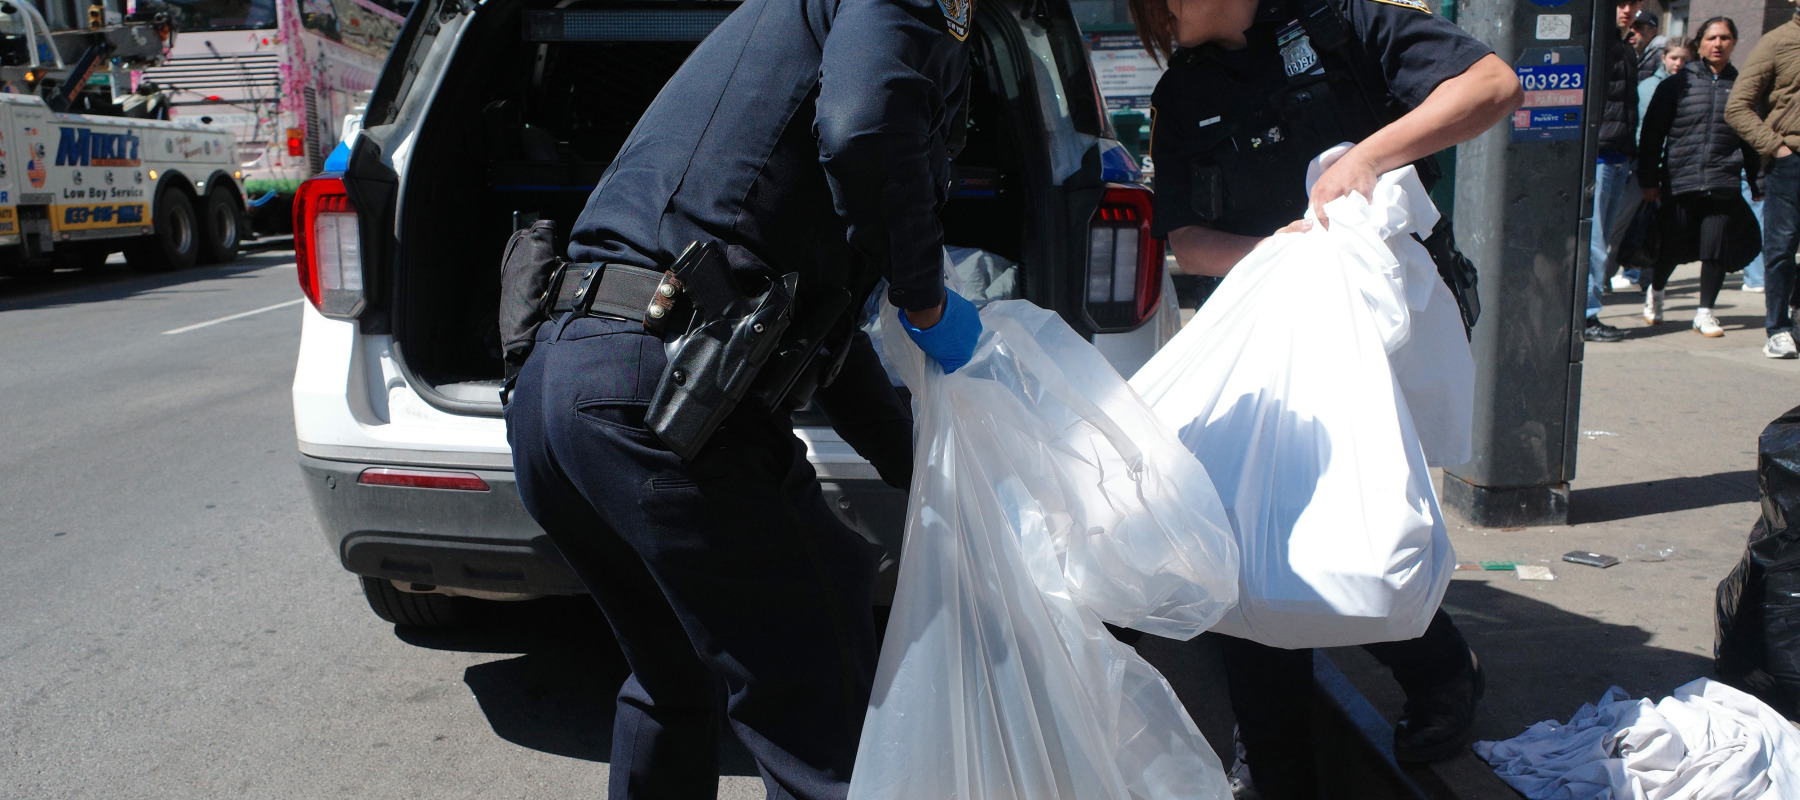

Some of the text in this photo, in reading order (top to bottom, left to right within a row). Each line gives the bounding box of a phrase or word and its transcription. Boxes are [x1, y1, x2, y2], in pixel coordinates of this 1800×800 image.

[1518, 73, 1581, 90] 103923
[64, 187, 143, 200] Low Boy Service
